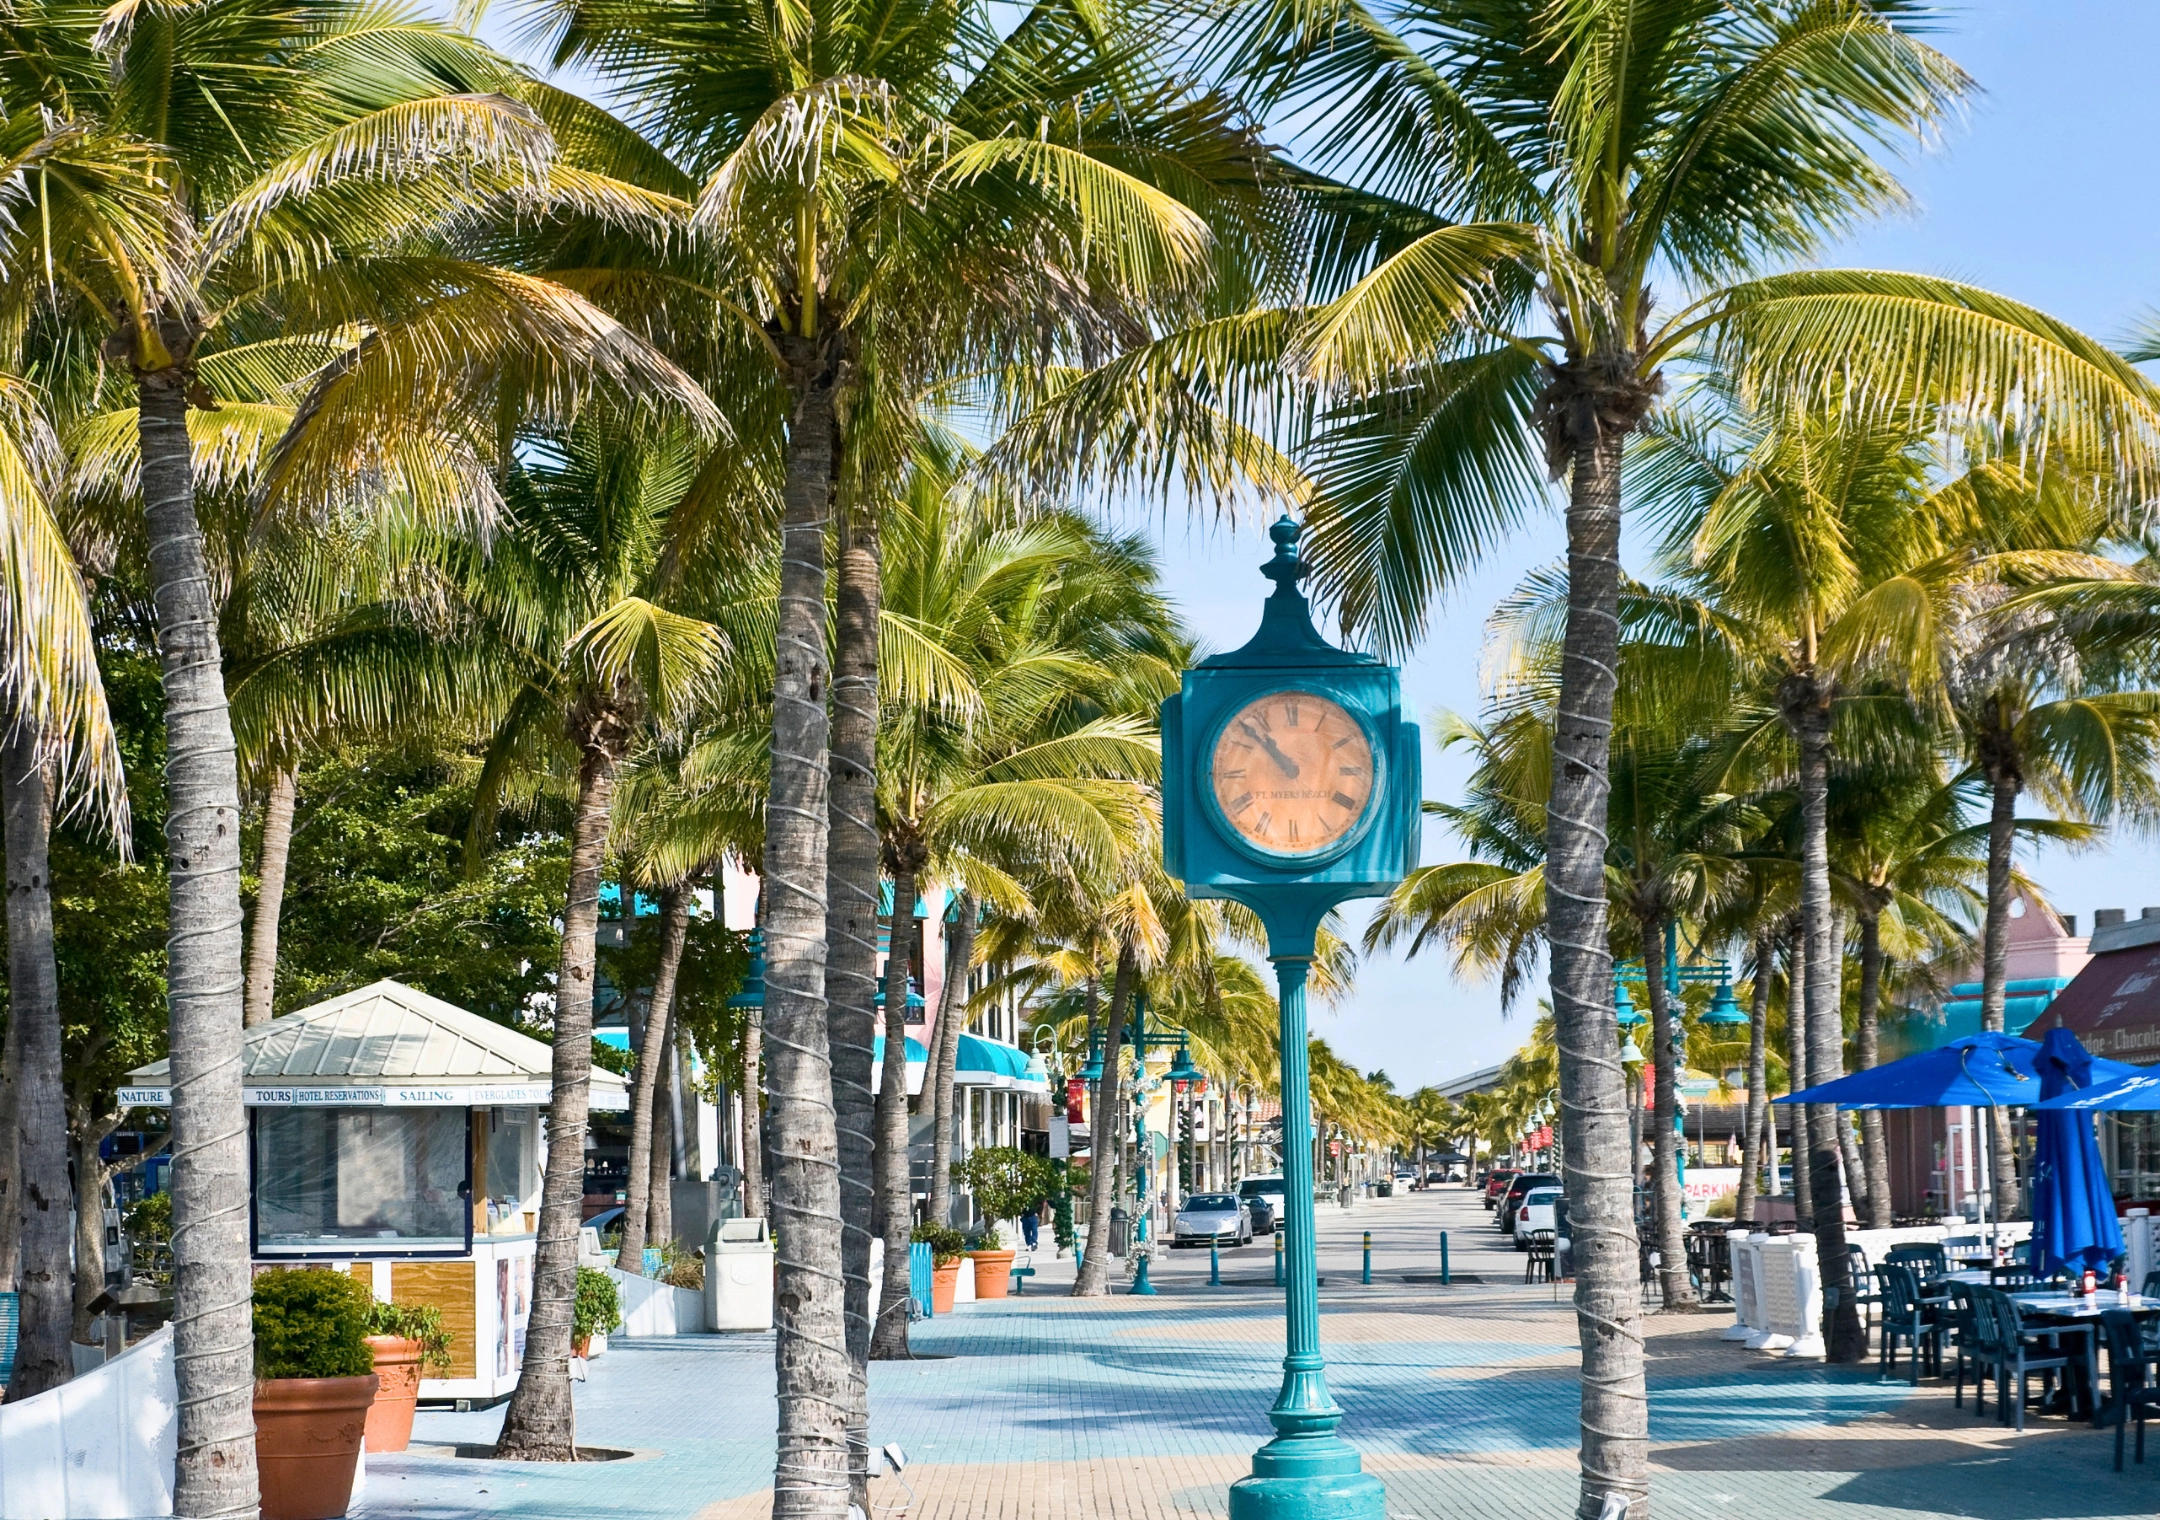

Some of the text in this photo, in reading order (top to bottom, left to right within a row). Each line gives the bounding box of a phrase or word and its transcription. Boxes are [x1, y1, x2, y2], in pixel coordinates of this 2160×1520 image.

[1270, 790, 1299, 799] MYERS
[121, 1091, 164, 1102] NATURE
[256, 1091, 291, 1101] TOURS
[298, 1090, 379, 1101] HOTEL RESERVATIONS
[400, 1091, 453, 1101] SAILING
[475, 1089, 527, 1100] EVERGLADES
